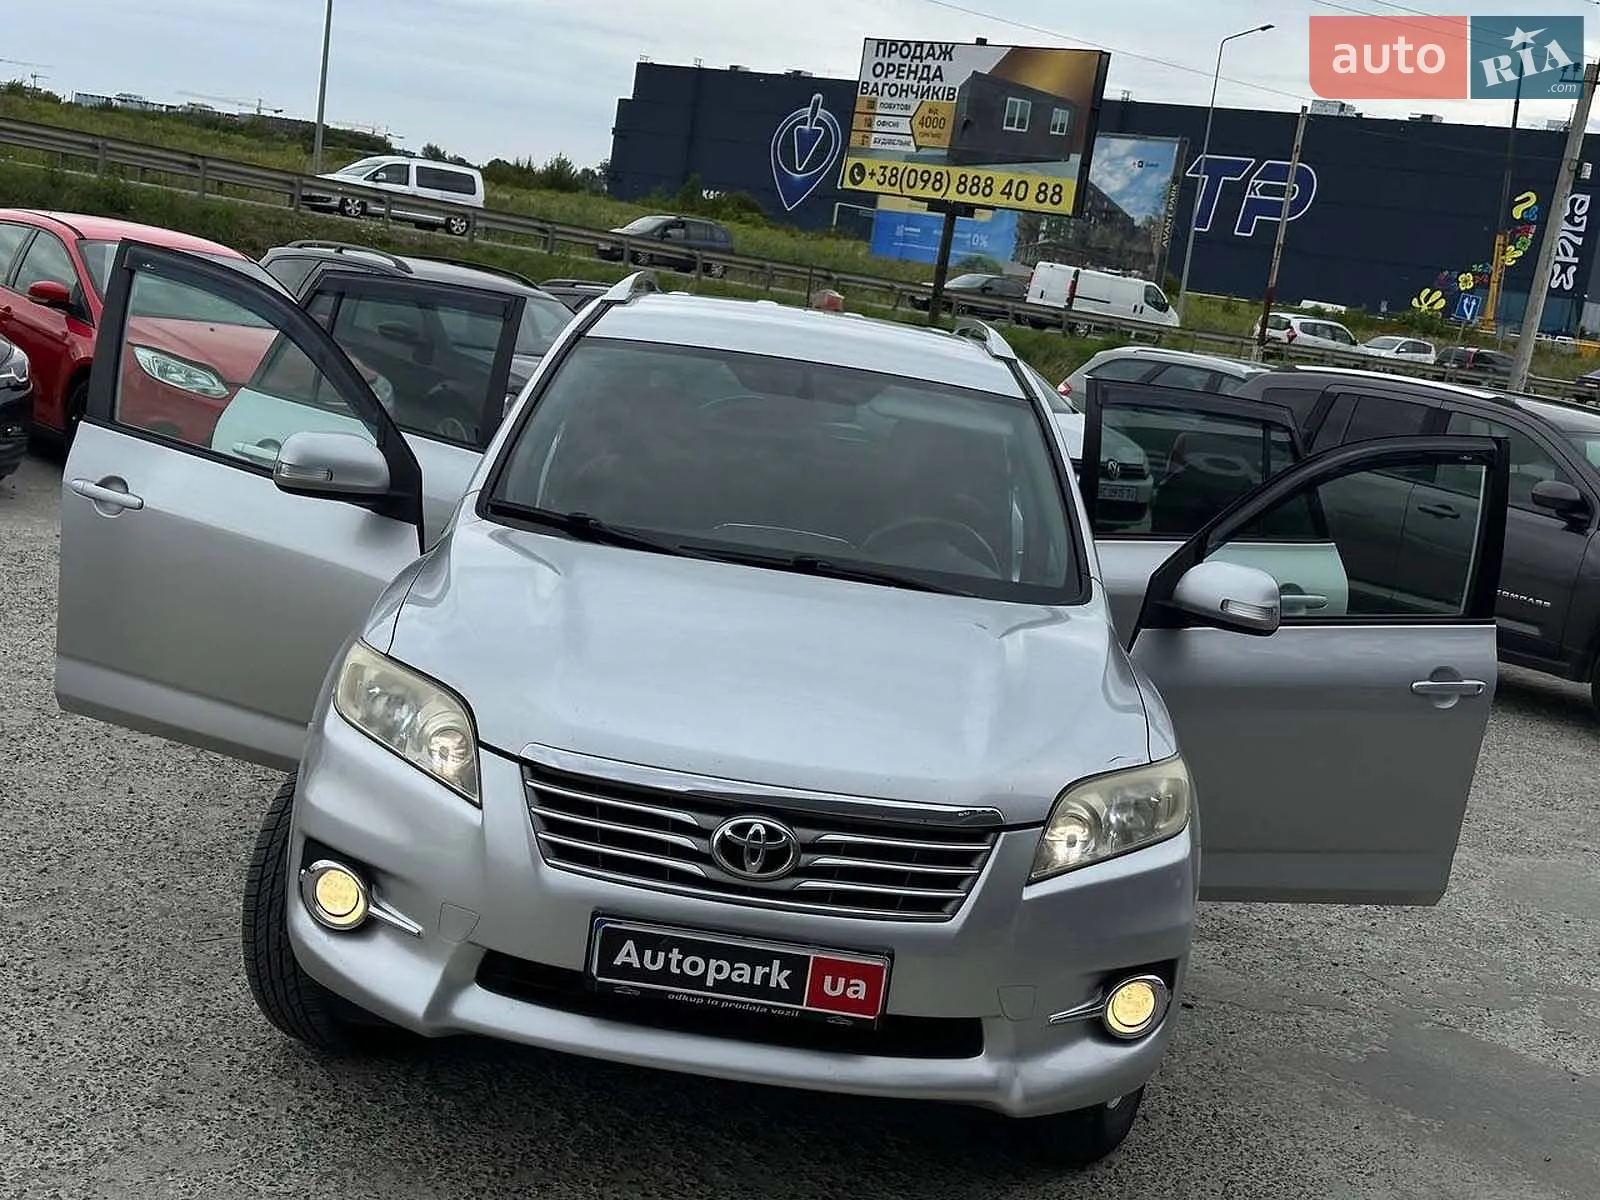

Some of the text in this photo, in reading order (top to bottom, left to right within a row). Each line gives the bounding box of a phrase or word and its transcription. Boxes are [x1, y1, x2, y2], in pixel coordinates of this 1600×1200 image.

[875, 41, 956, 63] ПРОДАЖ
[872, 62, 944, 84] ОРЕНДА
[860, 81, 957, 101] ВАГОНЧИКІВ
[918, 115, 946, 130] 4000
[868, 165, 1063, 206] +38(098) 888 40 88
[613, 939, 867, 1001] Autopark ua
